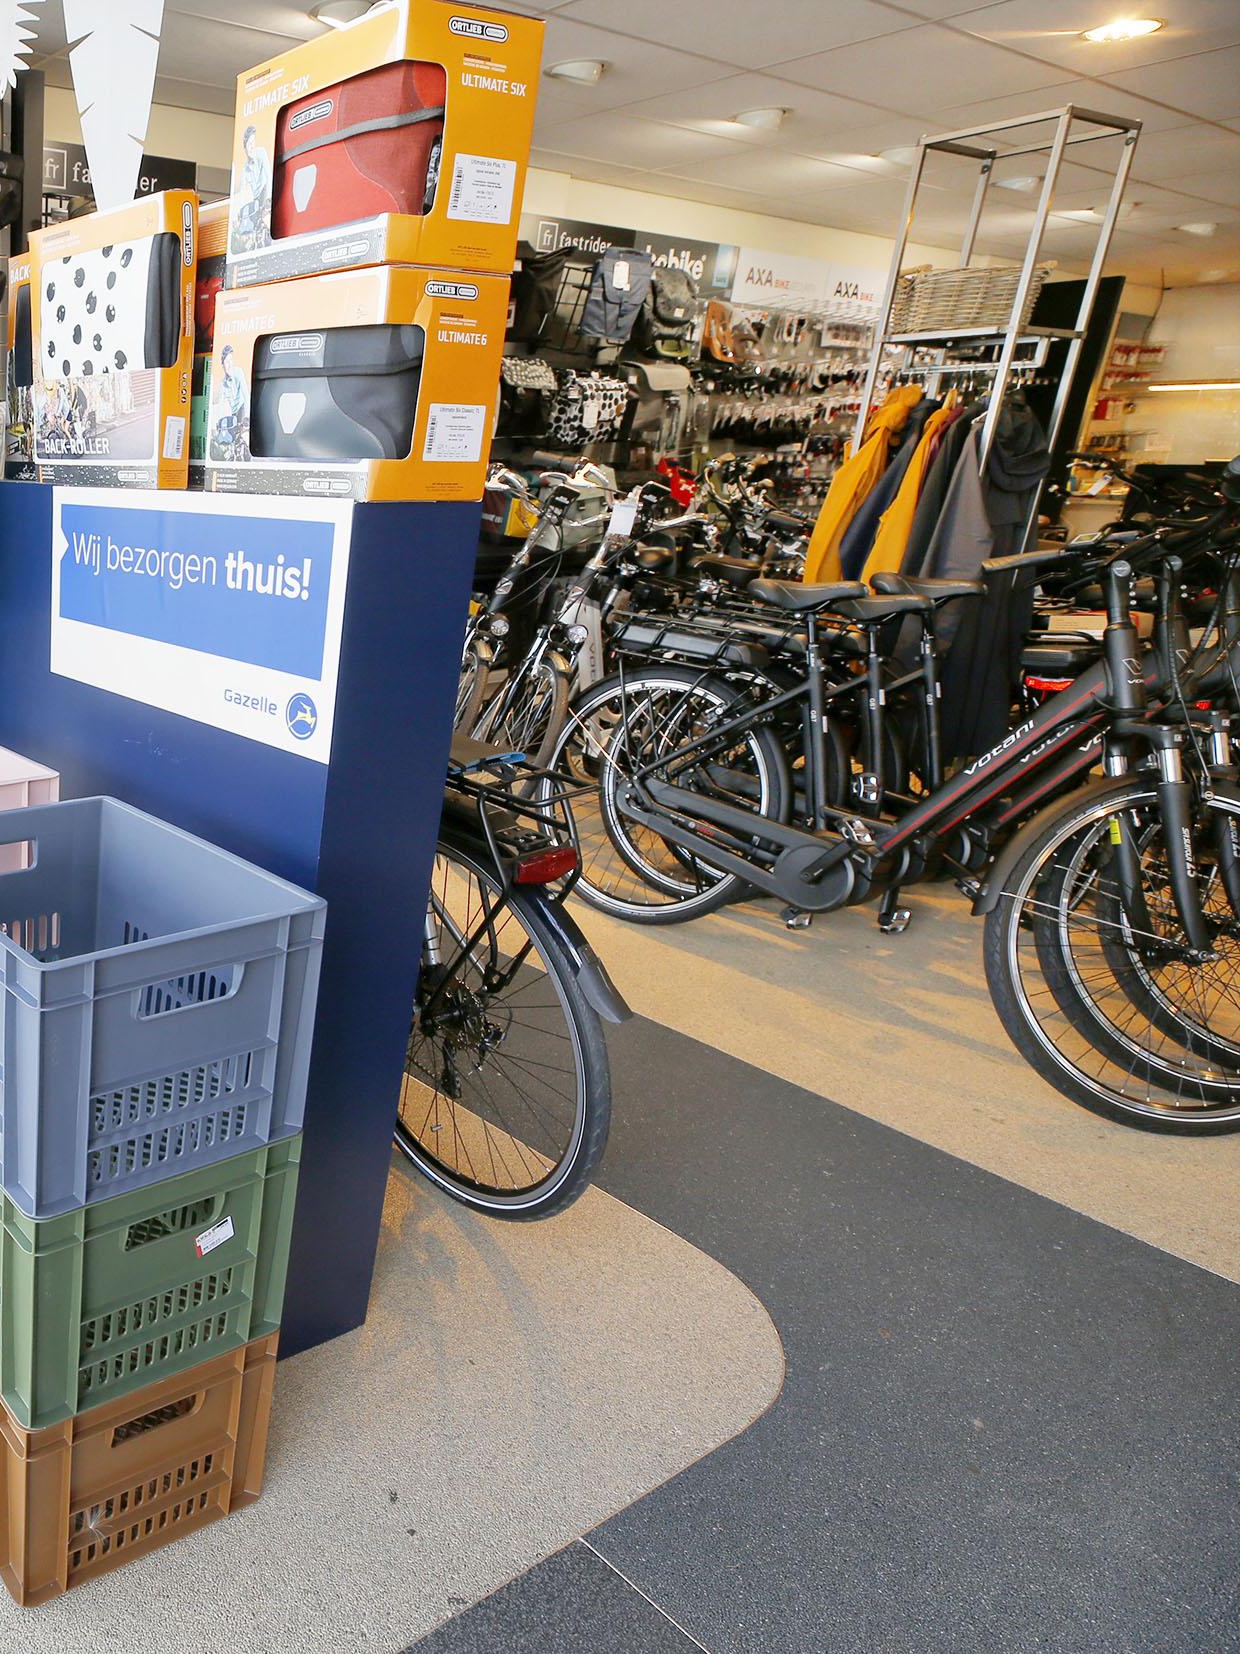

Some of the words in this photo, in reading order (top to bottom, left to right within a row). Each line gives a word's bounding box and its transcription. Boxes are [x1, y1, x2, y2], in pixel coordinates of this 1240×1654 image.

[452, 20, 482, 35] ORTLIEB
[462, 72, 509, 94] ULTIMATE
[510, 82, 527, 97] SIX
[243, 83, 290, 118] ULTIMATE
[292, 75, 310, 97] SIX
[745, 266, 774, 287] AXA
[428, 284, 456, 295] ORTLIEB
[834, 281, 859, 300] AXA
[45, 437, 110, 455] BACK-ROLLER
[72, 532, 101, 576] Wij
[106, 535, 217, 590] bezorgen
[225, 550, 312, 601] thuis!
[224, 688, 278, 716] Gazelle
